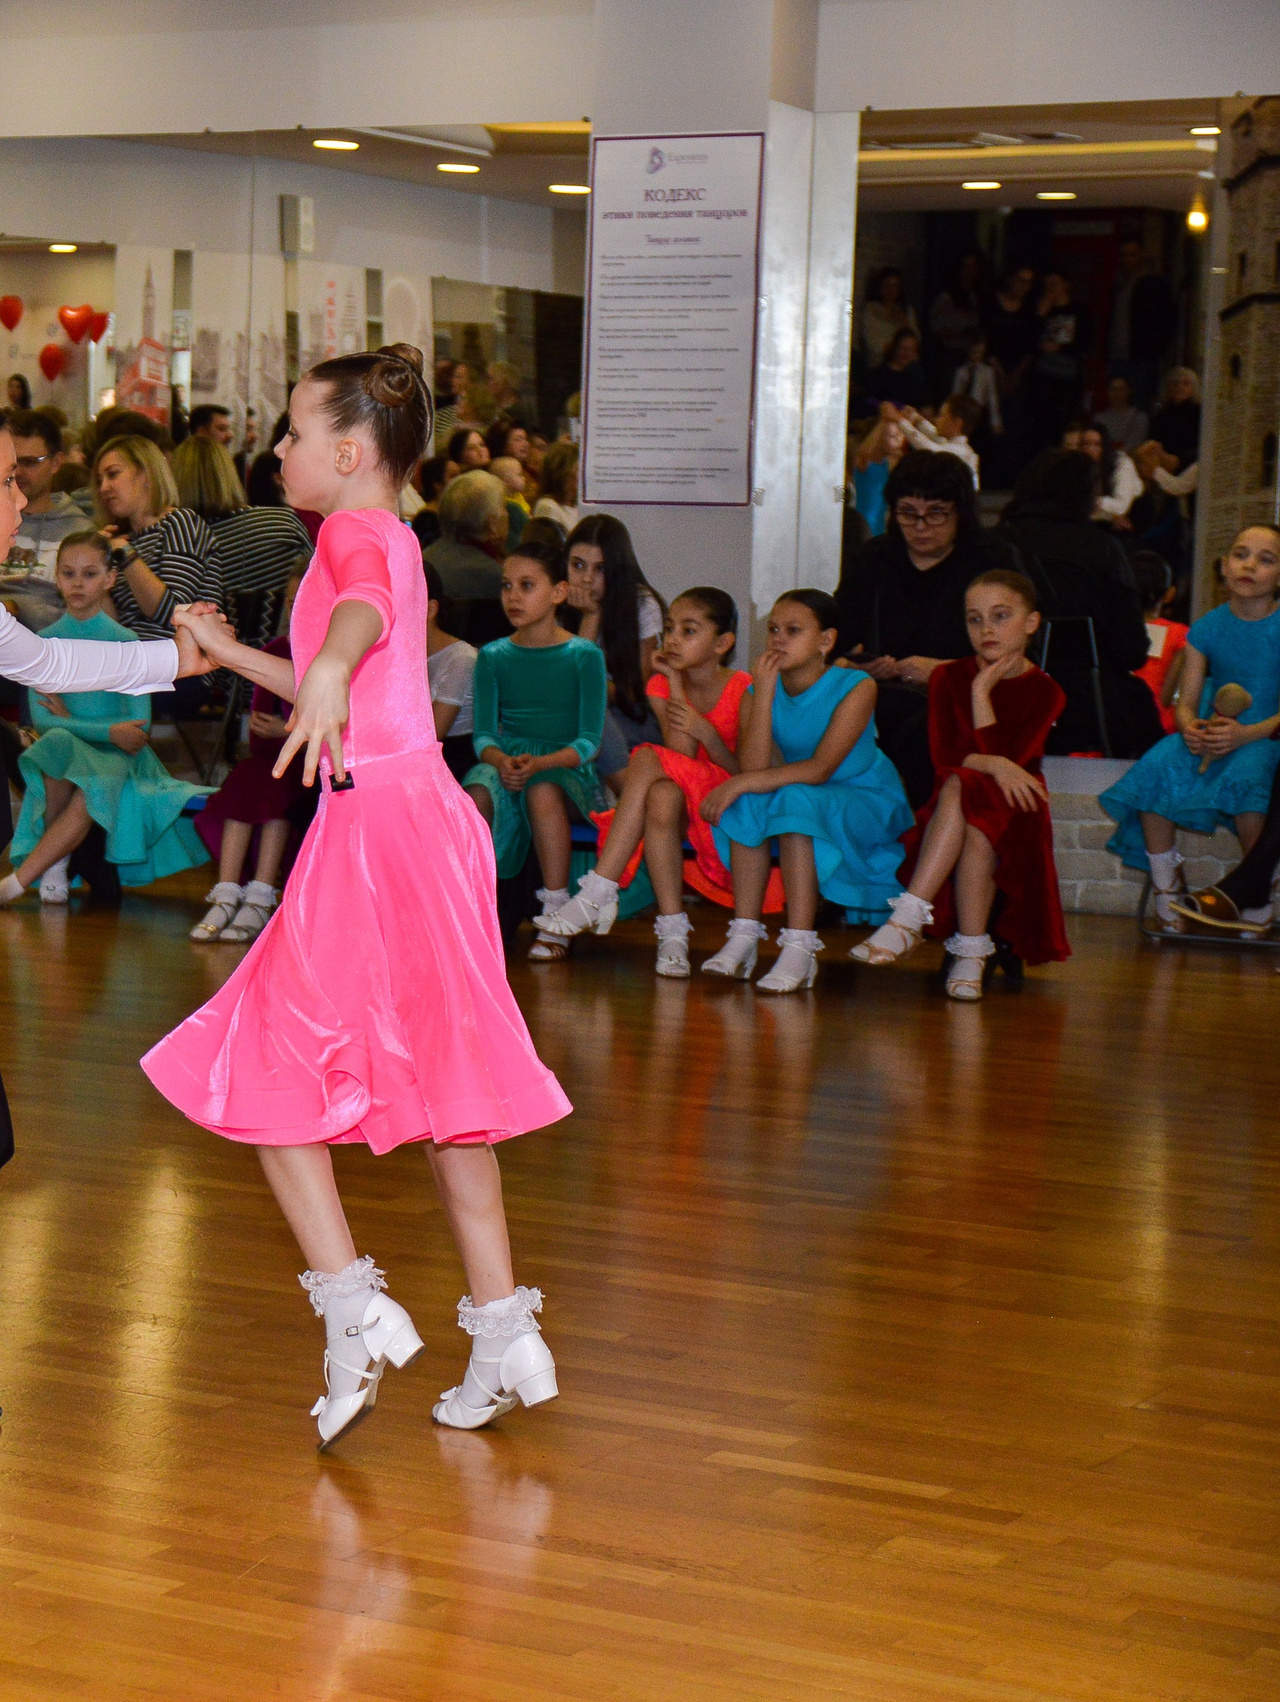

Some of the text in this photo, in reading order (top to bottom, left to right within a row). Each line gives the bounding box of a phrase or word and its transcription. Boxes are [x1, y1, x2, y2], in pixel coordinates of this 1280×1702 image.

[644, 188, 707, 203] КОДЕКС
[636, 210, 694, 219] поведения
[697, 208, 748, 220] танцоров
